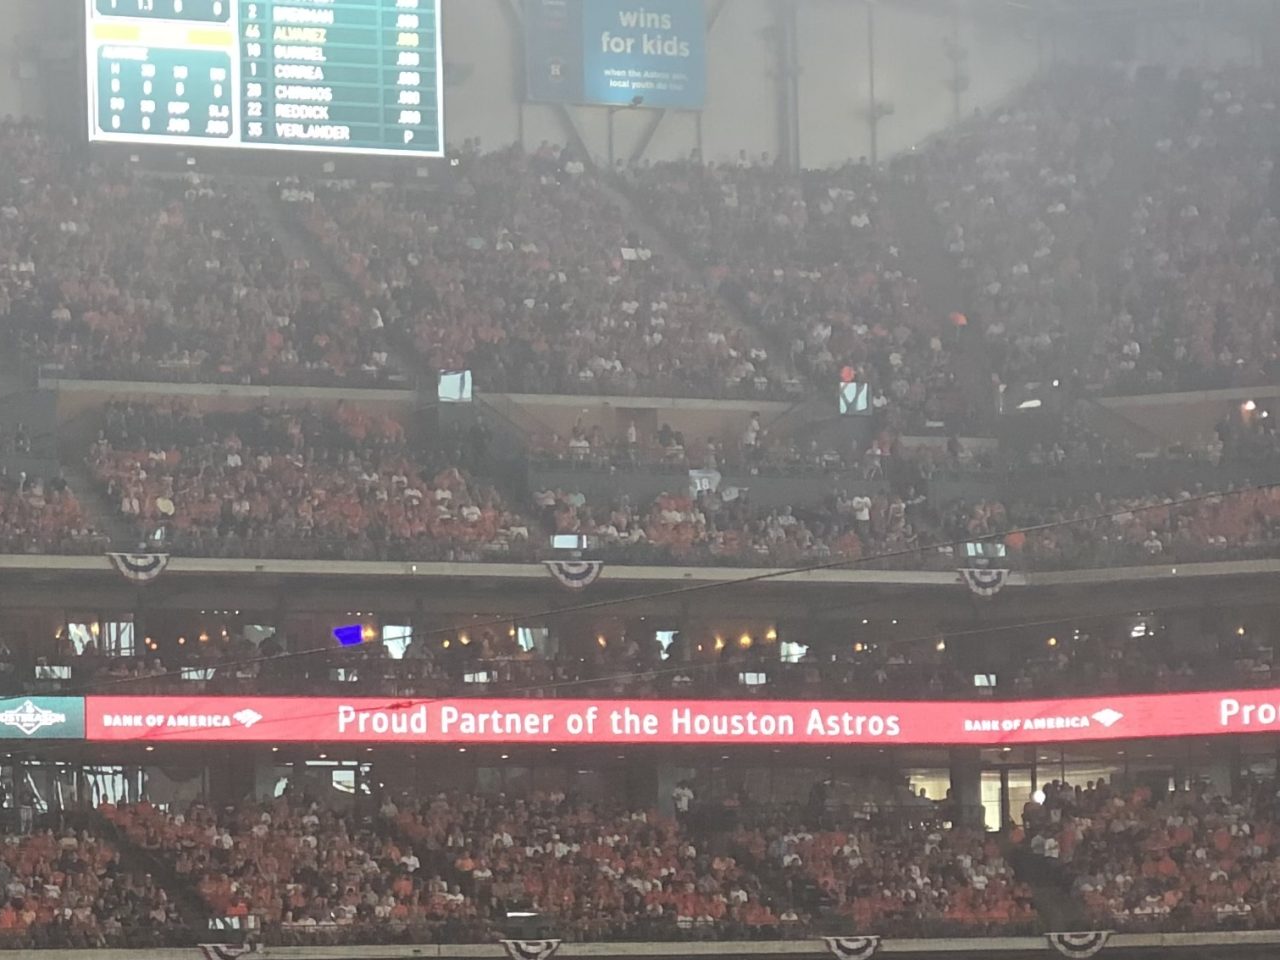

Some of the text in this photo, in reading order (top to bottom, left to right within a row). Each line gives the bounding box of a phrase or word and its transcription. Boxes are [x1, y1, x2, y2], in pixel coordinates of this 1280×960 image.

[619, 8, 671, 29] wins
[601, 31, 690, 57] for kids
[251, 62, 257, 76] 1
[274, 64, 324, 80] CORREA
[604, 69, 626, 78] when
[628, 69, 642, 78] the
[610, 79, 629, 88] local
[631, 80, 654, 90] youth
[247, 102, 262, 117] 22
[275, 104, 329, 120] REDDICK
[276, 123, 350, 141] VERLANDER
[404, 130, 413, 144] P
[695, 478, 710, 491] 18
[103, 714, 232, 728] BANK OF AMERICA
[337, 705, 900, 736] Proud Partner of the Houston Astros
[1220, 698, 1280, 726] Pro
[964, 716, 1090, 731] BANK OF AMERICA
